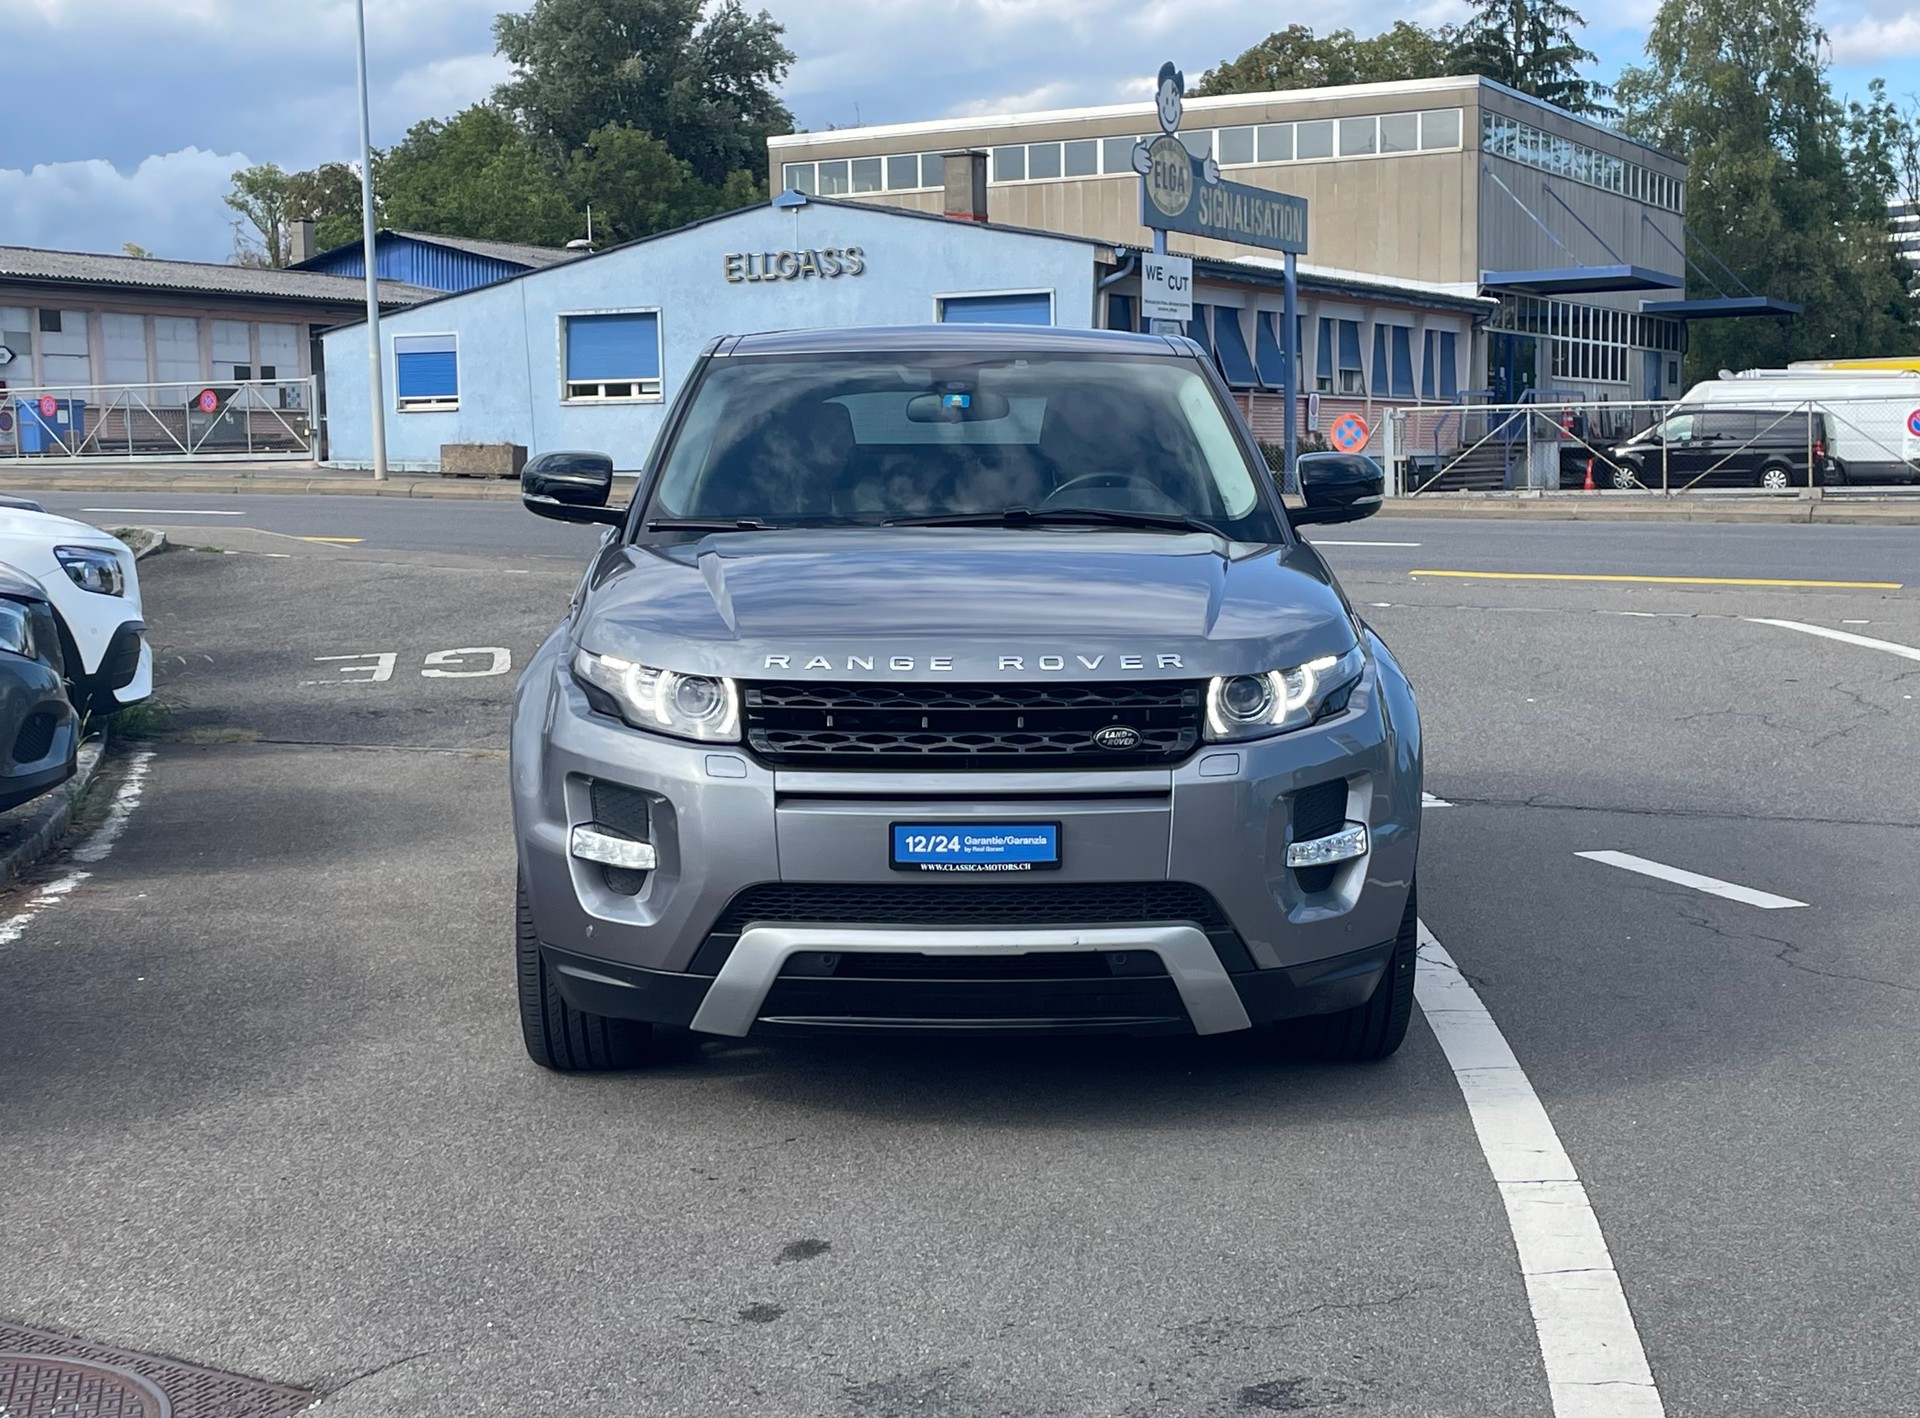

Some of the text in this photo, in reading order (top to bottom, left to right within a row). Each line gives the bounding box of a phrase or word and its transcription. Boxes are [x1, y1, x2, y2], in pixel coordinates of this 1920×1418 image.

[1154, 160, 1186, 194] ELGA
[1199, 186, 1303, 243] SIGNALISATION
[724, 247, 865, 282] ELLGASS
[1145, 264, 1189, 291] WE CUT
[764, 653, 1185, 672] RANGE ROVER
[905, 835, 1047, 853] 12/24 Garantie/Garanzia
[920, 863, 1031, 872] WWW.CLASSICA-MOTORS.CH
